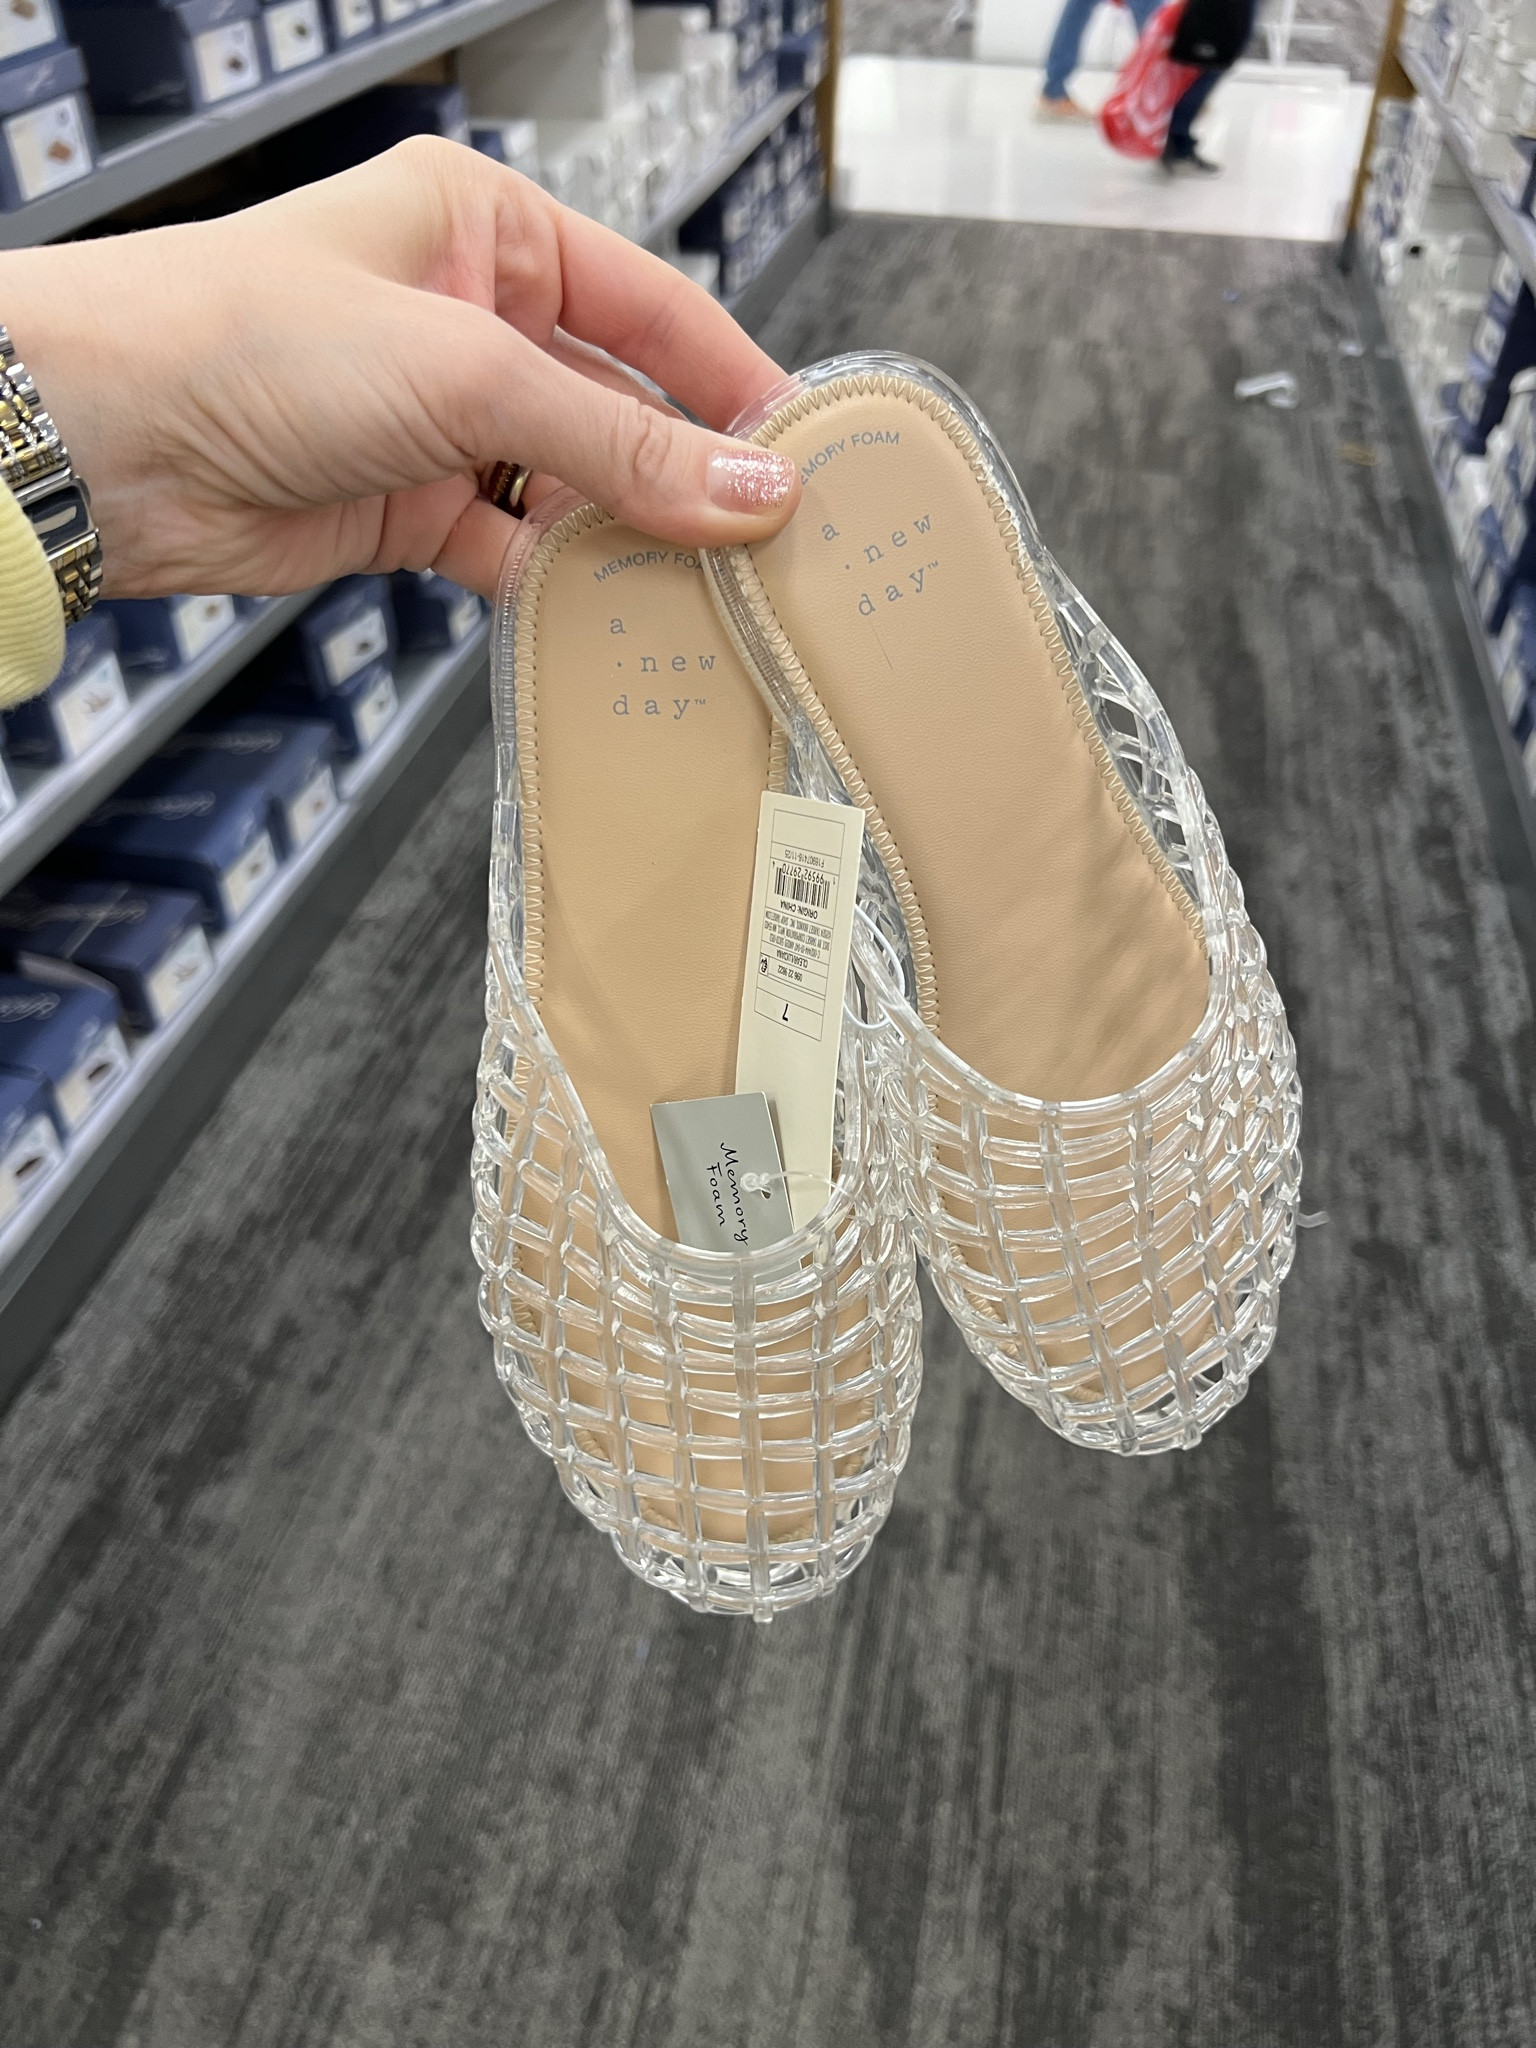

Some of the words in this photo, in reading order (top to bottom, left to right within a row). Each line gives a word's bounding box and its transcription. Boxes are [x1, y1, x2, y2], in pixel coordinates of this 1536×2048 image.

[851, 431, 900, 447] FOAM
[821, 523, 840, 541] a
[594, 551, 668, 583] MEMORY
[610, 618, 627, 634] a
[781, 863, 801, 878] 29770
[804, 869, 825, 885] 99592
[780, 900, 797, 913] CHINA
[796, 904, 818, 920] ORIGIN:
[782, 1003, 789, 1022] 7
[706, 1162, 726, 1227] Foam
[720, 1143, 749, 1246] Memory
